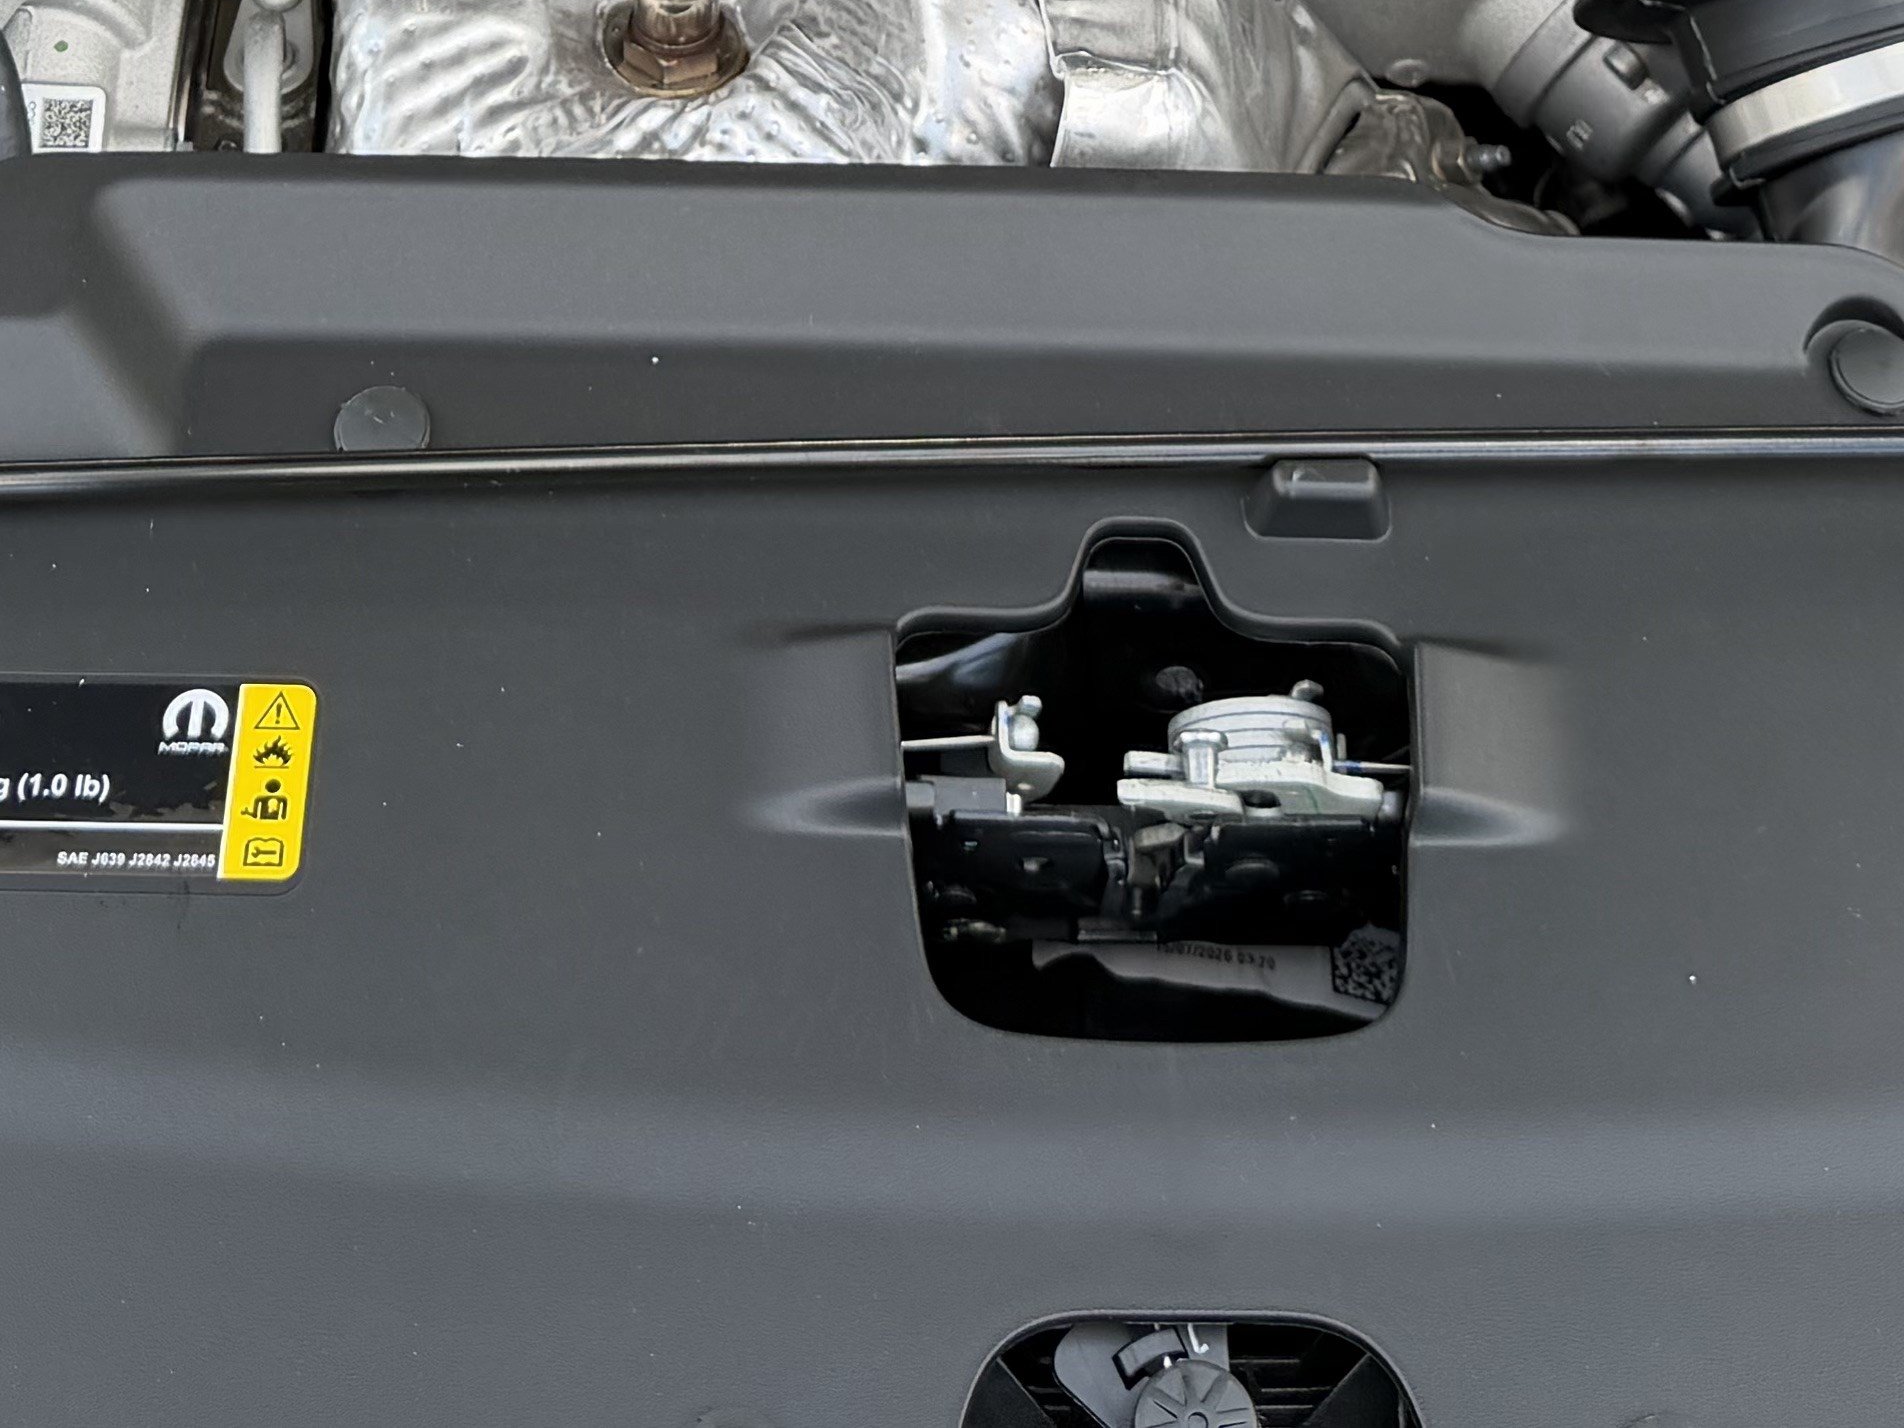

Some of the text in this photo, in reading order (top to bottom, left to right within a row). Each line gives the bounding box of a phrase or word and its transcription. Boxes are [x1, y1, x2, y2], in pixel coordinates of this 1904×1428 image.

[156, 739, 228, 756] MOPAR
[17, 772, 68, 801] (1.0
[74, 772, 111, 803] lb)
[56, 850, 89, 866] SAE
[91, 851, 127, 867] J639
[129, 852, 172, 868] J2842
[173, 853, 217, 869] J2845
